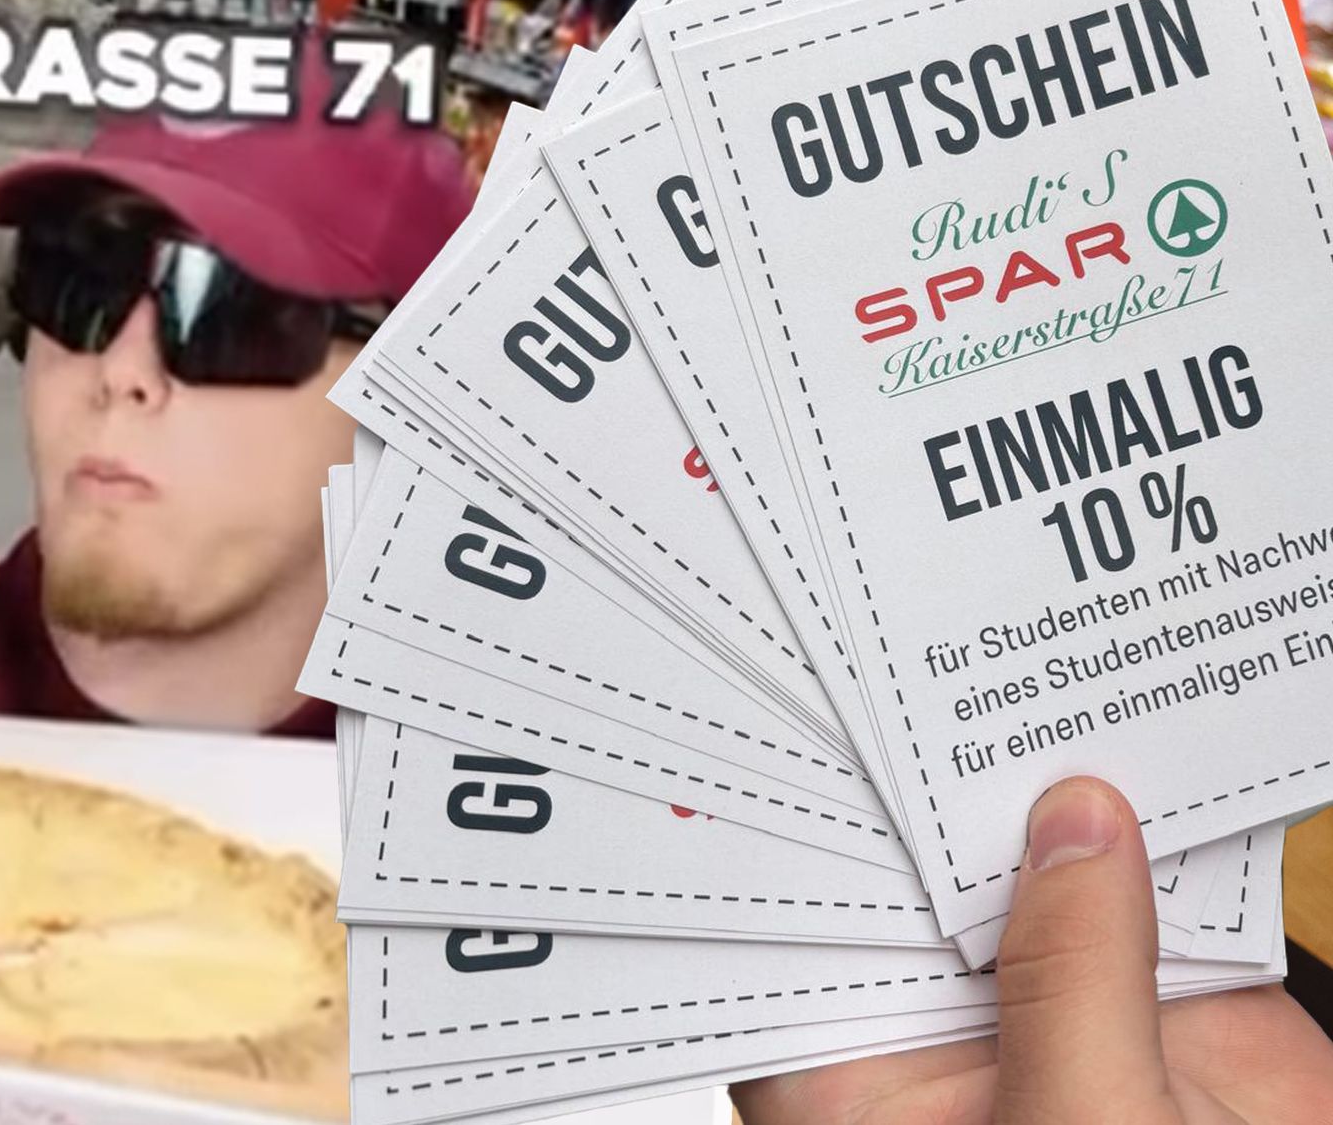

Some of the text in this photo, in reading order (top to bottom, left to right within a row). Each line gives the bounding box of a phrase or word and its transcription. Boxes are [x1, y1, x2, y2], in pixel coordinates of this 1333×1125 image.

[854, 221, 1132, 344] SPAR
[922, 344, 1264, 522] EINMALIG
[1041, 463, 1219, 583] 10 %
[925, 527, 1333, 679] für Studenten mit Nachw
[950, 743, 997, 779] für
[1006, 708, 1095, 760] einen
[1102, 648, 1280, 725] einmaligen
[953, 671, 1041, 722] eines
